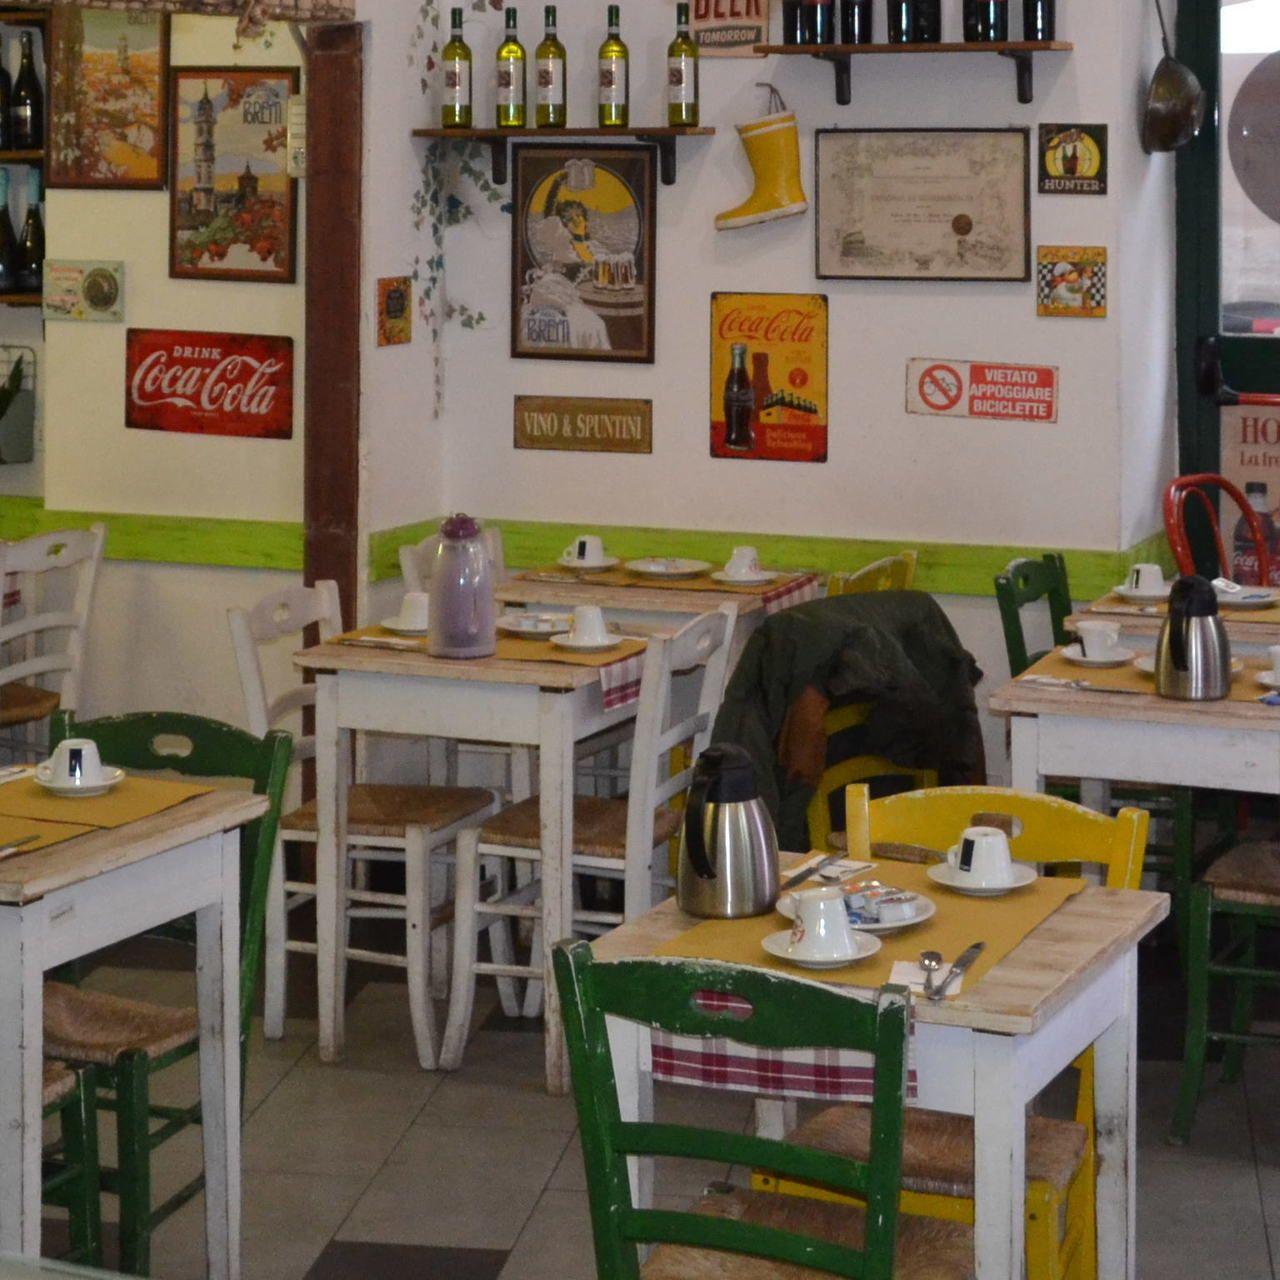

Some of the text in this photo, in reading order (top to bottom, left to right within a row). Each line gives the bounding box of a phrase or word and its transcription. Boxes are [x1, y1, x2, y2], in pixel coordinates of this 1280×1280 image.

[701, 29, 757, 44] TOMORROW
[1043, 178, 1101, 191] HUNTER
[173, 346, 222, 360] DRINK
[132, 350, 284, 415] Coca-Cola
[984, 368, 1037, 385] VIETATO
[969, 384, 1053, 401] APPOGGIARE
[973, 399, 1047, 416] BICICLETTE
[524, 412, 642, 439] VINO & SPUNTINI
[1240, 451, 1261, 466] La
